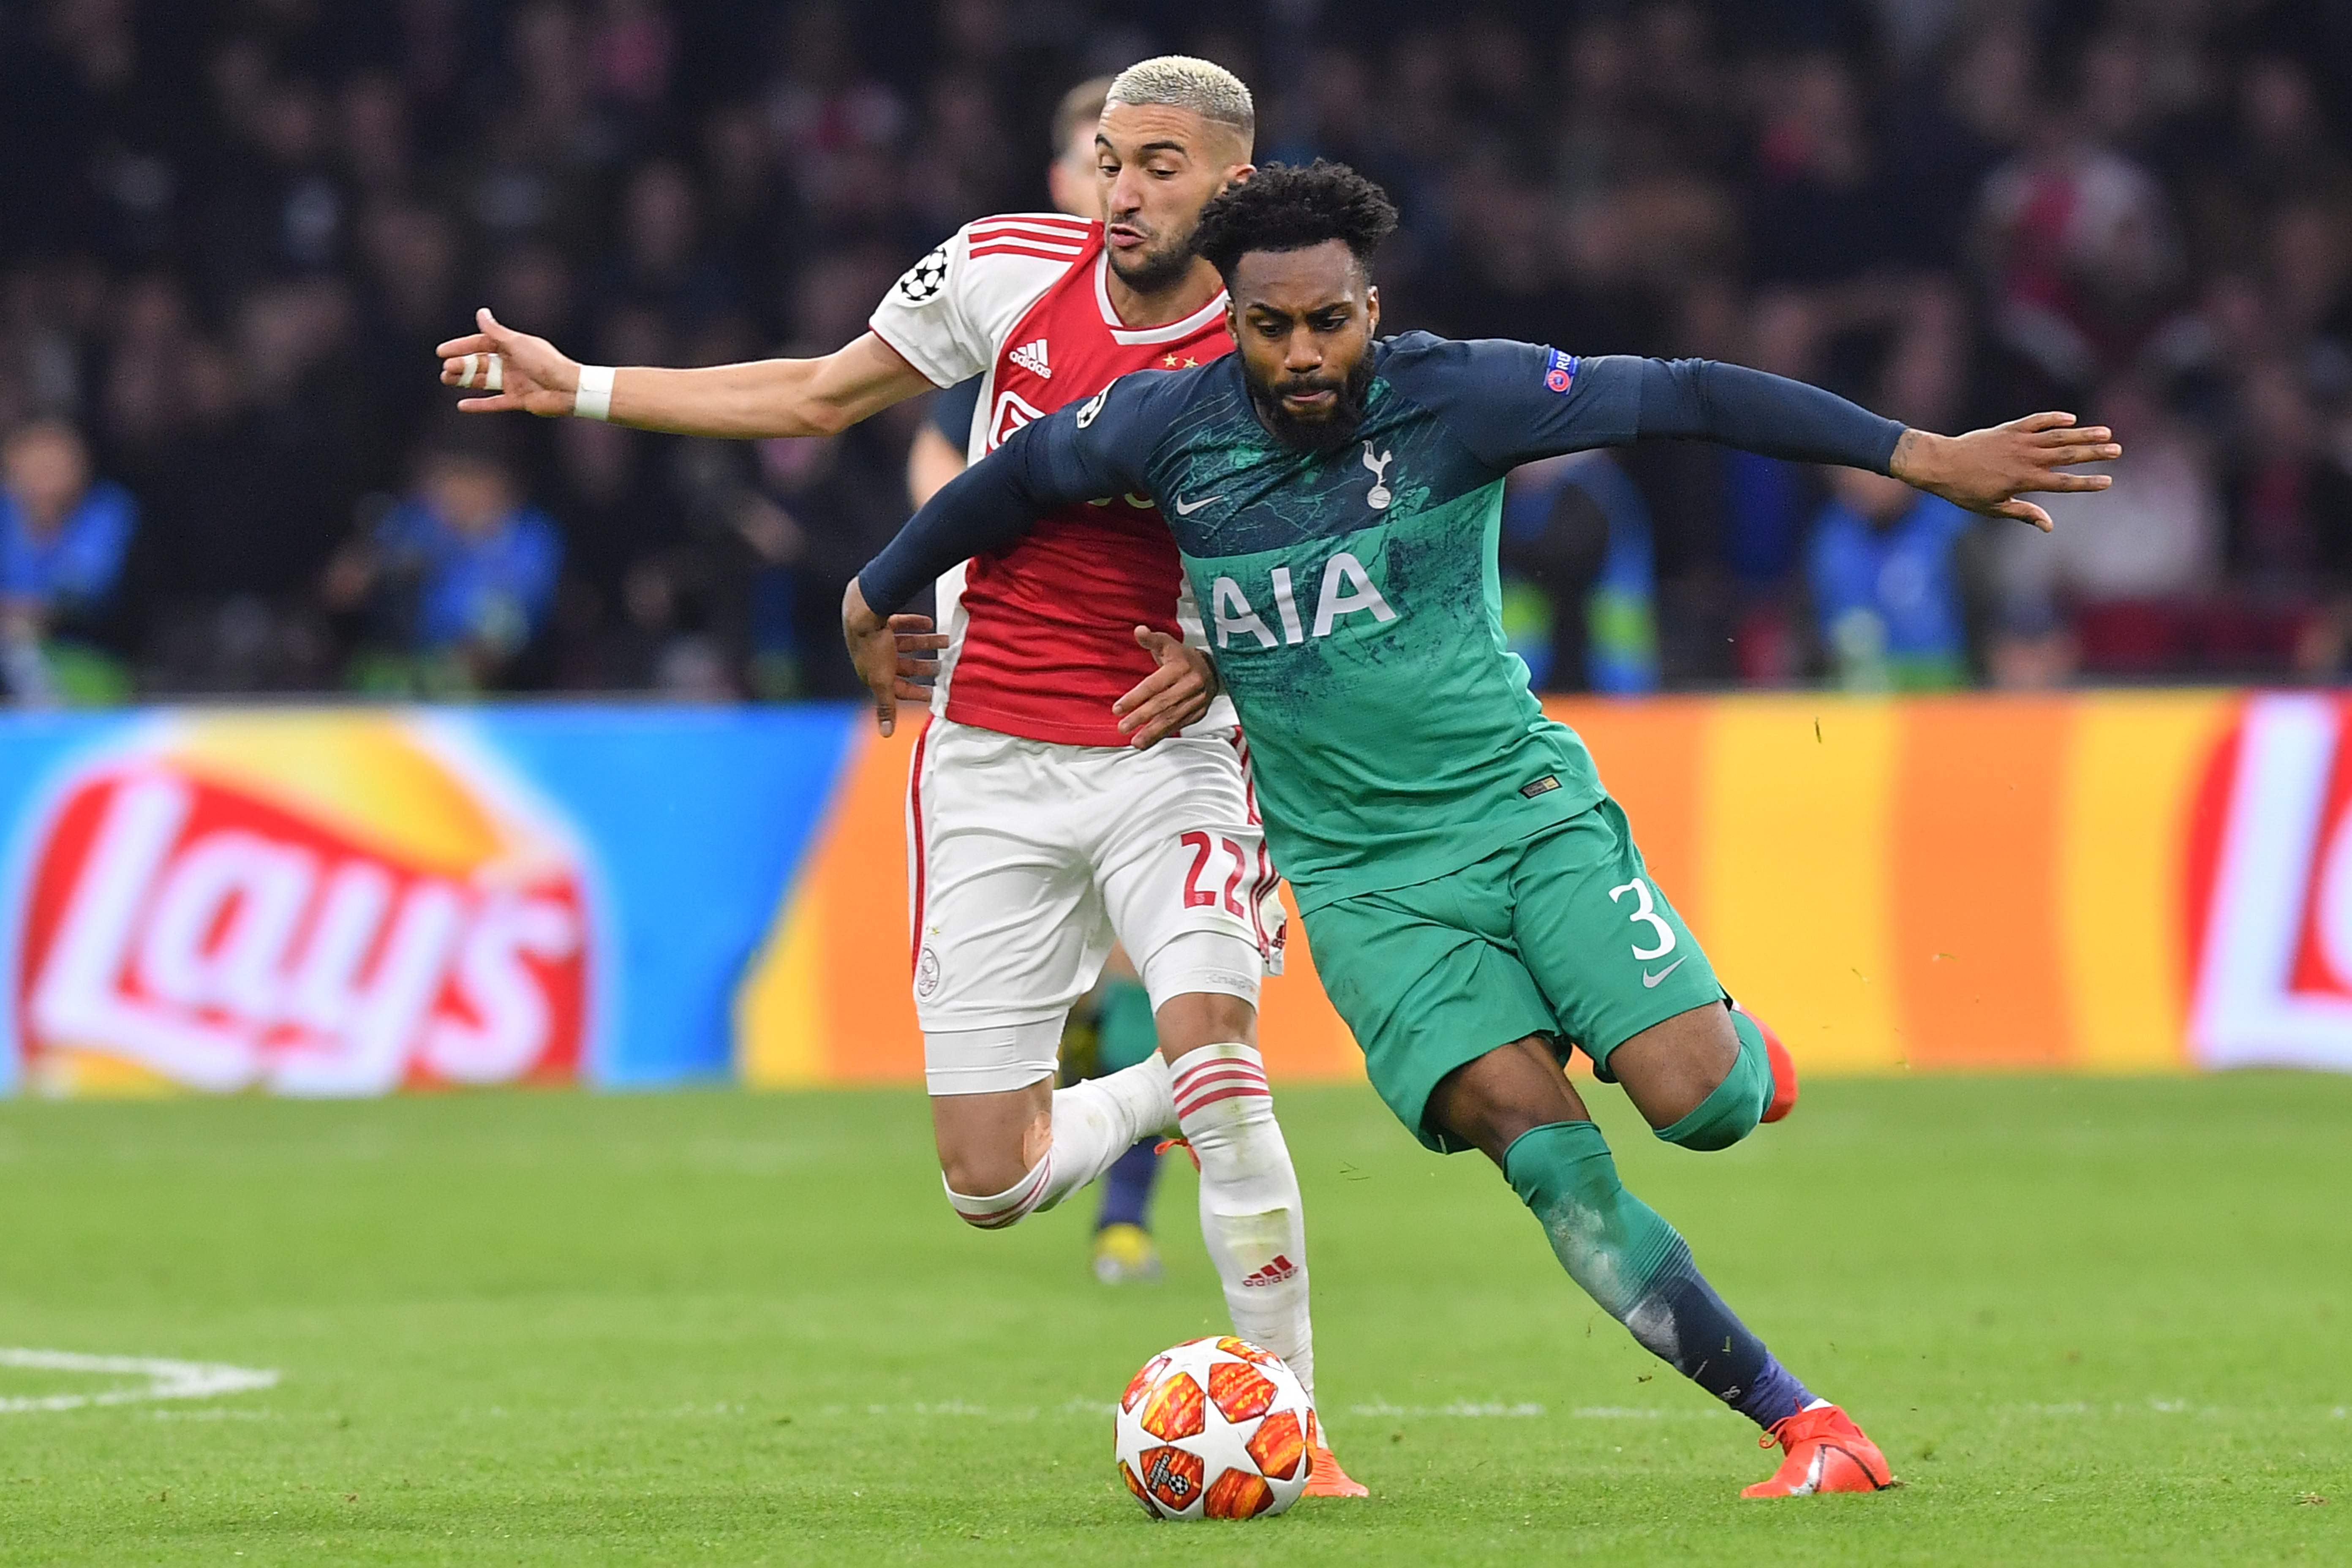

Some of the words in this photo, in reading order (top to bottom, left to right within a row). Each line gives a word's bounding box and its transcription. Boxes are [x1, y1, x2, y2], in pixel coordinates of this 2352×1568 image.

[1009, 351, 1052, 379] adidas
[1213, 552, 1396, 648] AIA
[1181, 830, 1245, 920] 22
[1608, 877, 1676, 960] 3
